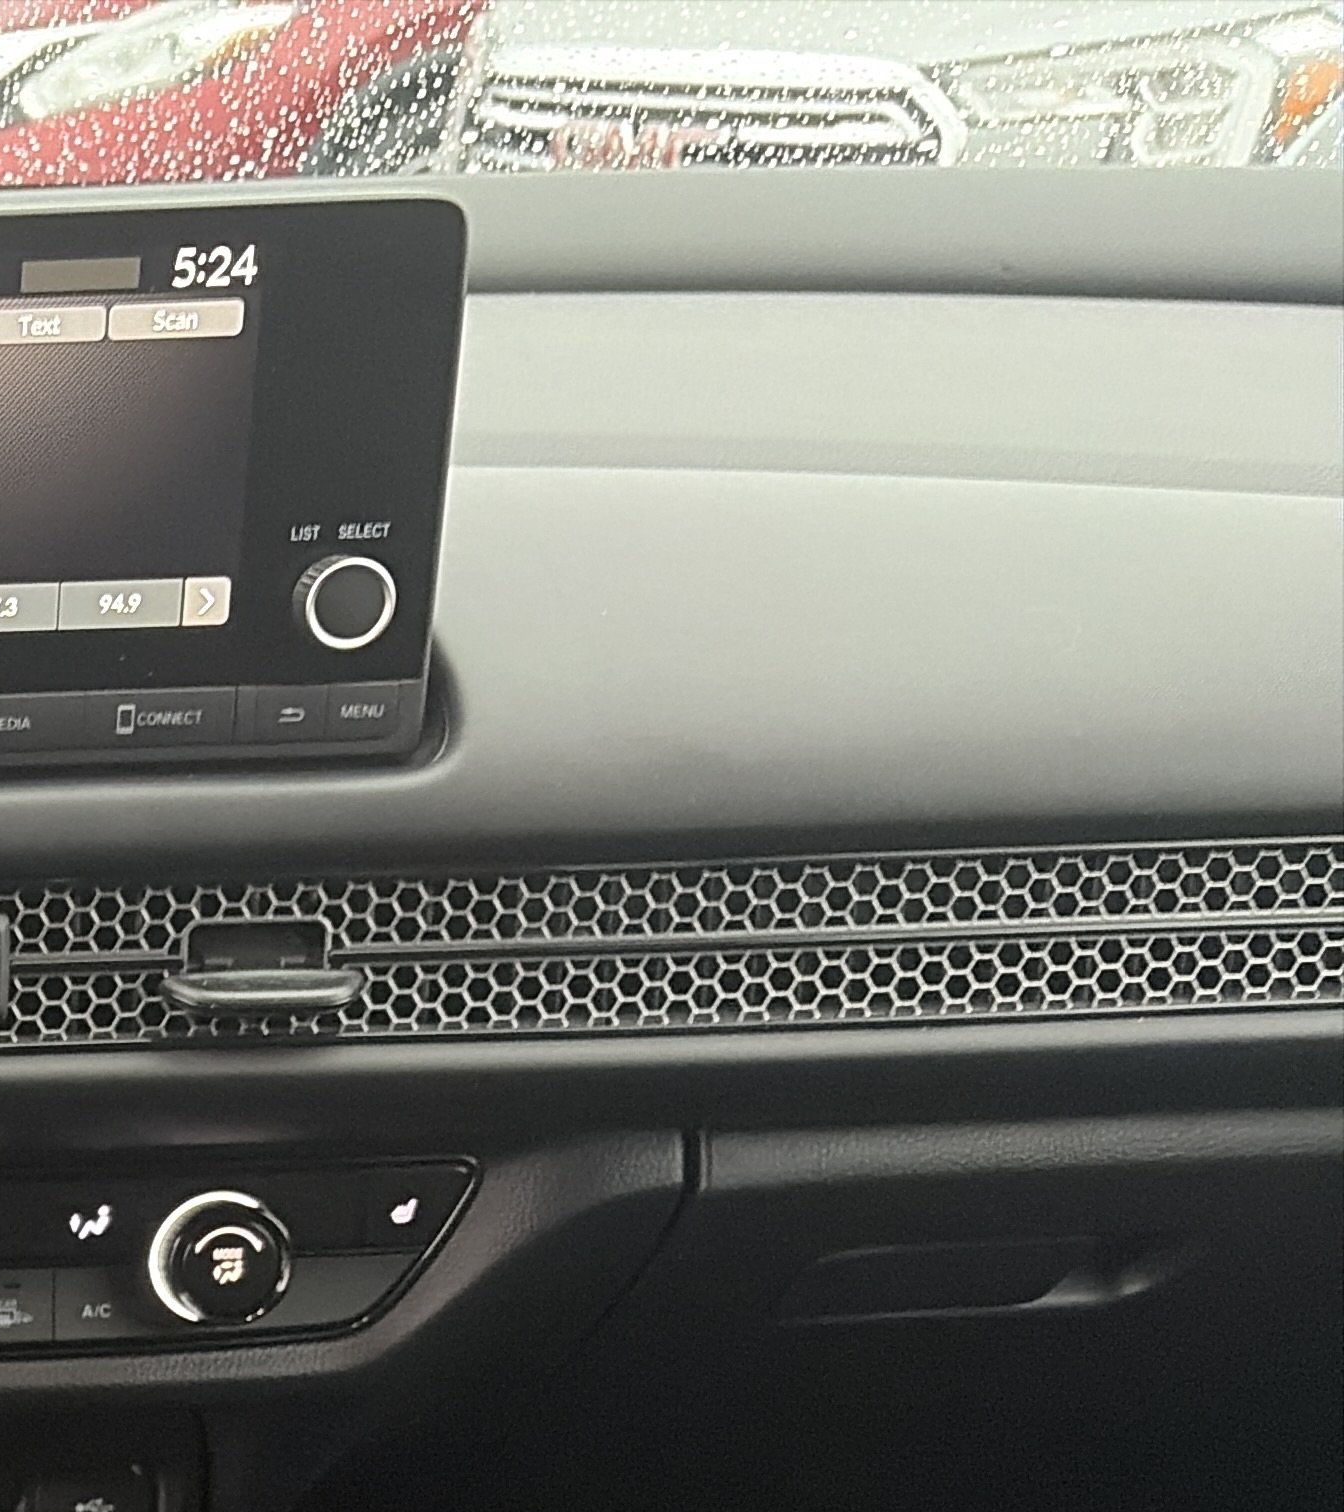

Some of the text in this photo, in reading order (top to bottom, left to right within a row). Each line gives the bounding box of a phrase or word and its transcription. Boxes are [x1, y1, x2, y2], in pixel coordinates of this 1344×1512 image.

[172, 245, 259, 288] 5:24
[18, 314, 61, 338] Text
[153, 309, 198, 332] Scan
[290, 523, 321, 542] LIST
[337, 521, 392, 540] SELECT
[98, 592, 143, 615] 94.9
[136, 709, 203, 727] CONNECT
[340, 704, 385, 720] MENU
[81, 1303, 112, 1319] A/C
